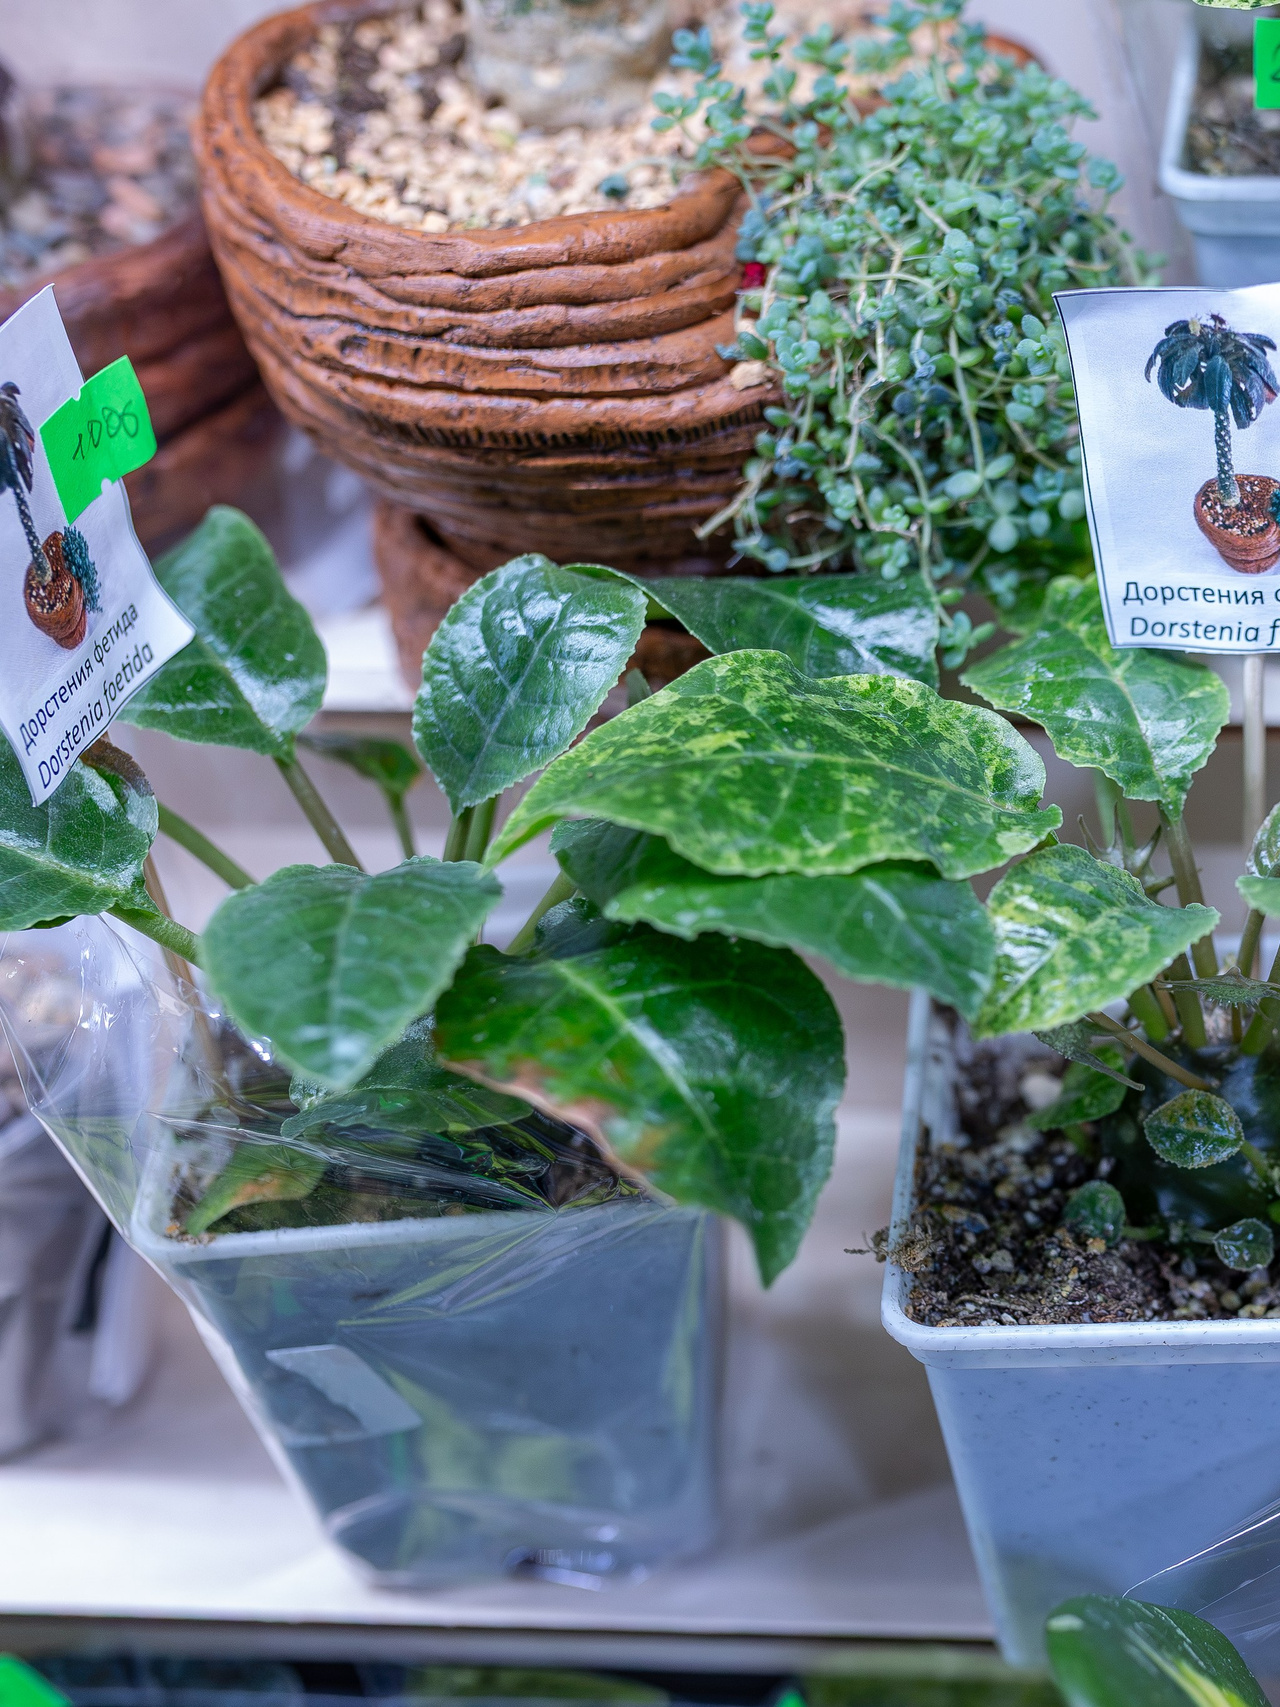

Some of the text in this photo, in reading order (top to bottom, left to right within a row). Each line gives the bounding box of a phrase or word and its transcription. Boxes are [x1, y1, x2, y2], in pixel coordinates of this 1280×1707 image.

[1122, 581, 1265, 606] Дорстения
[1130, 616, 1260, 643] Dorstenia
[19, 603, 139, 757] Дорстения фетида
[37, 641, 154, 789] Dorstenia foetida
